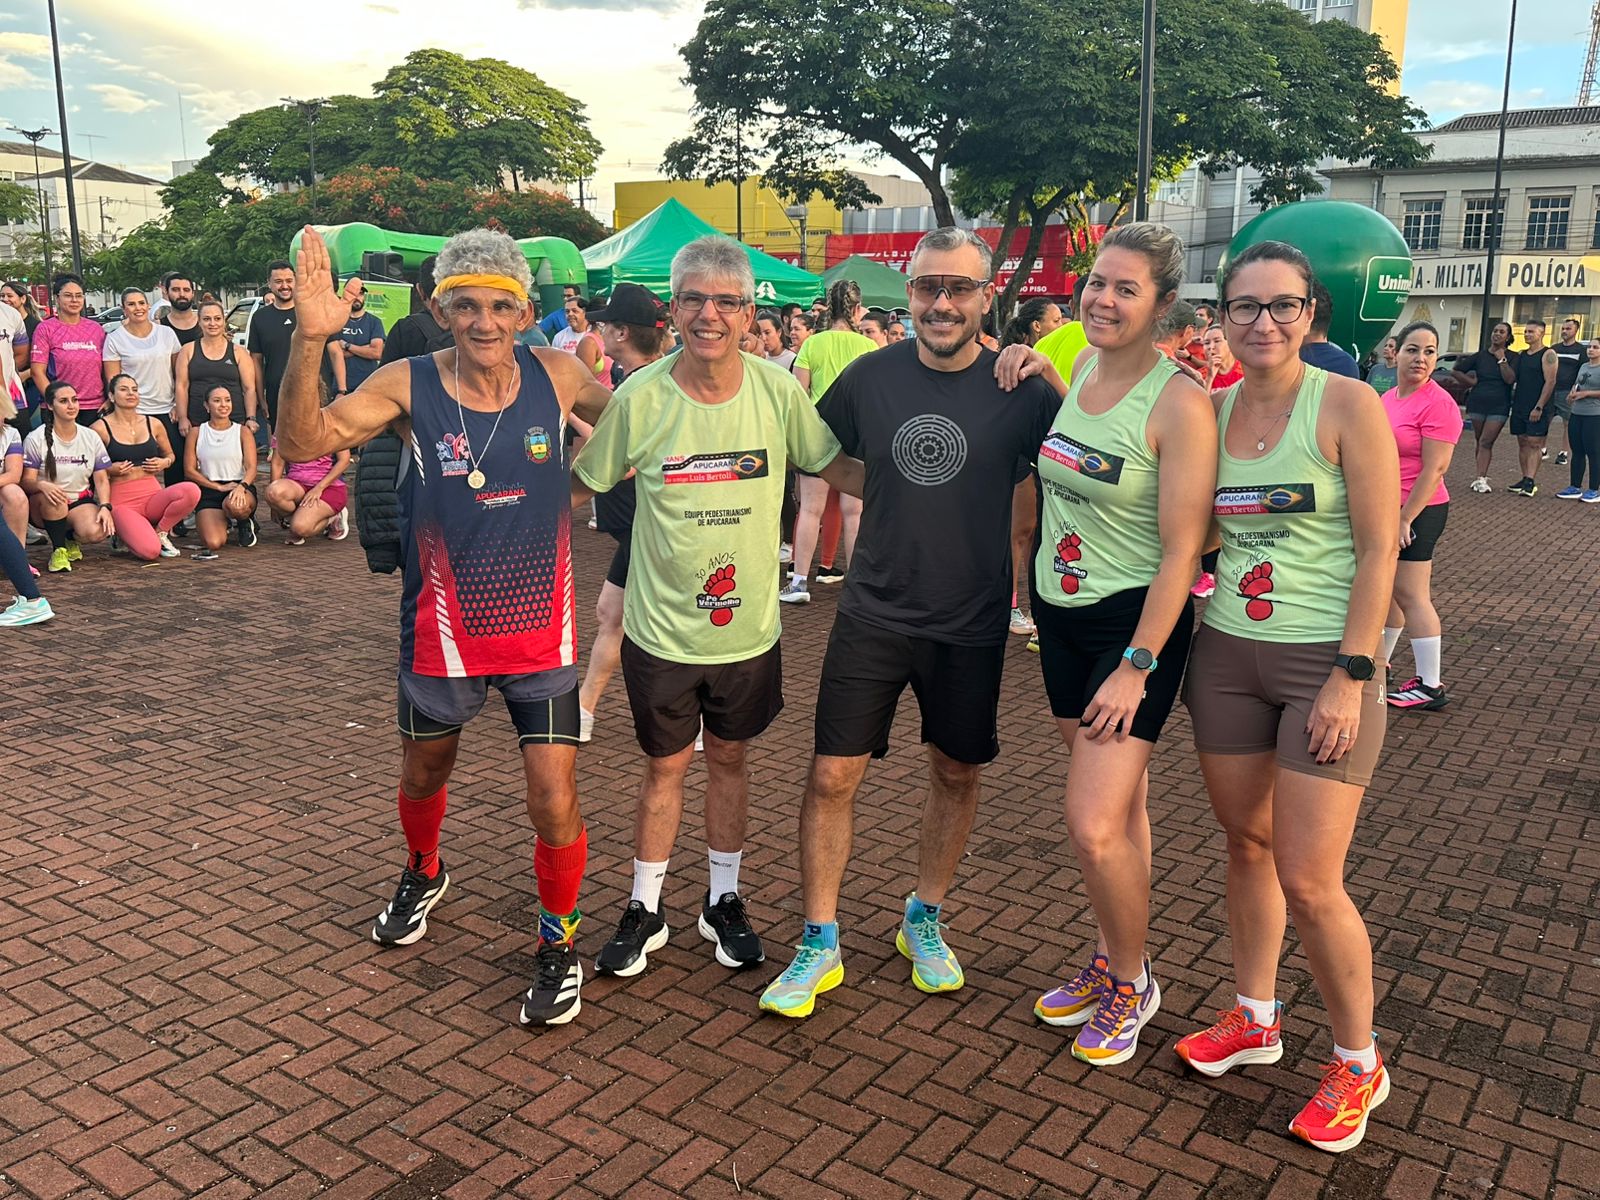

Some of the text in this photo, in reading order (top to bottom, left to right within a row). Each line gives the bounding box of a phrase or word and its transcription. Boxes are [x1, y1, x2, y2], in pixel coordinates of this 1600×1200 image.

[1435, 263, 1491, 288] MILITA
[1507, 258, 1586, 288] POLÍCIA
[693, 460, 738, 469] APUCARANA
[689, 474, 706, 482] Luis
[707, 472, 732, 481] Bertoli
[476, 488, 526, 500] APUCARANA
[1219, 494, 1268, 502] APUCARANA
[684, 507, 752, 519] EQUIPE PEDESTRIANISMO
[706, 517, 740, 526] APUCARANA
[1237, 530, 1290, 540] PEDESTRIANISMO
[695, 551, 737, 582] 30 ANOS
[698, 598, 740, 607] Vermelho
